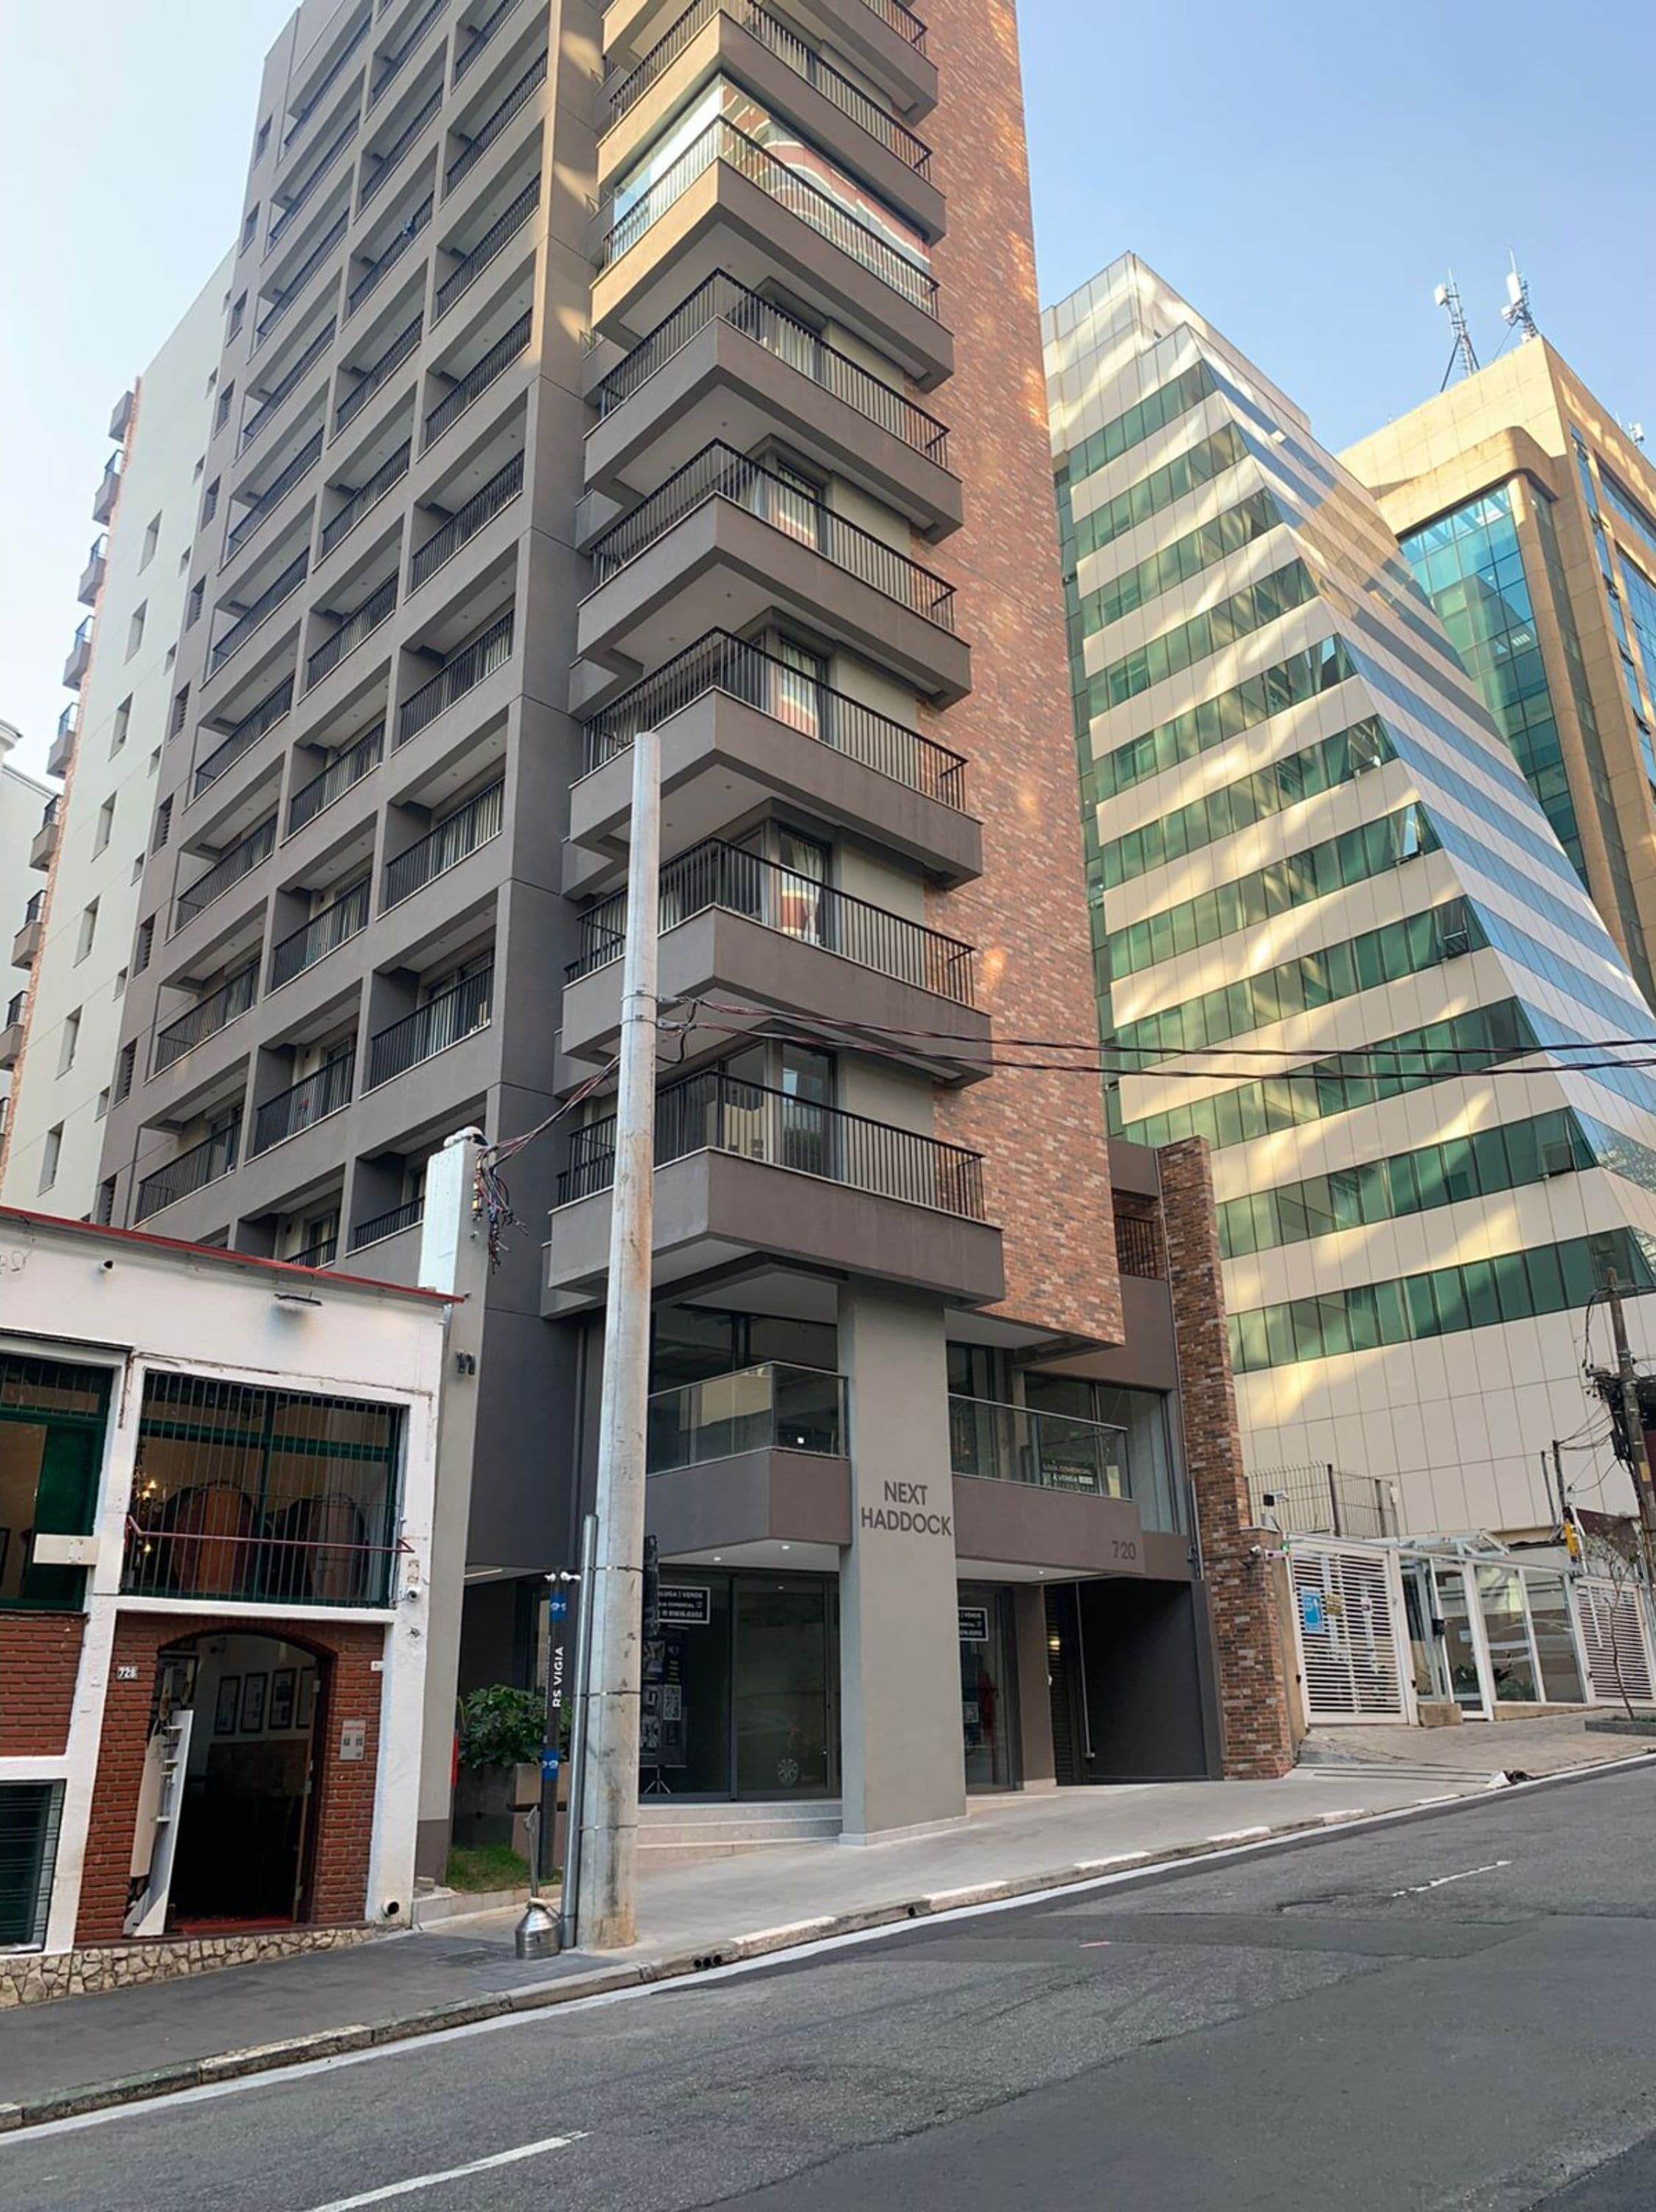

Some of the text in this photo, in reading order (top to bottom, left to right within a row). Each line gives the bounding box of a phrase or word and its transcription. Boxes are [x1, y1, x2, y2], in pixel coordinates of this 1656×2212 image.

[884, 1480, 928, 1505] NEXT
[861, 1506, 953, 1536] HADDOCK
[1111, 1540, 1136, 1560] 720
[552, 1646, 563, 1708] RS VIGIA
